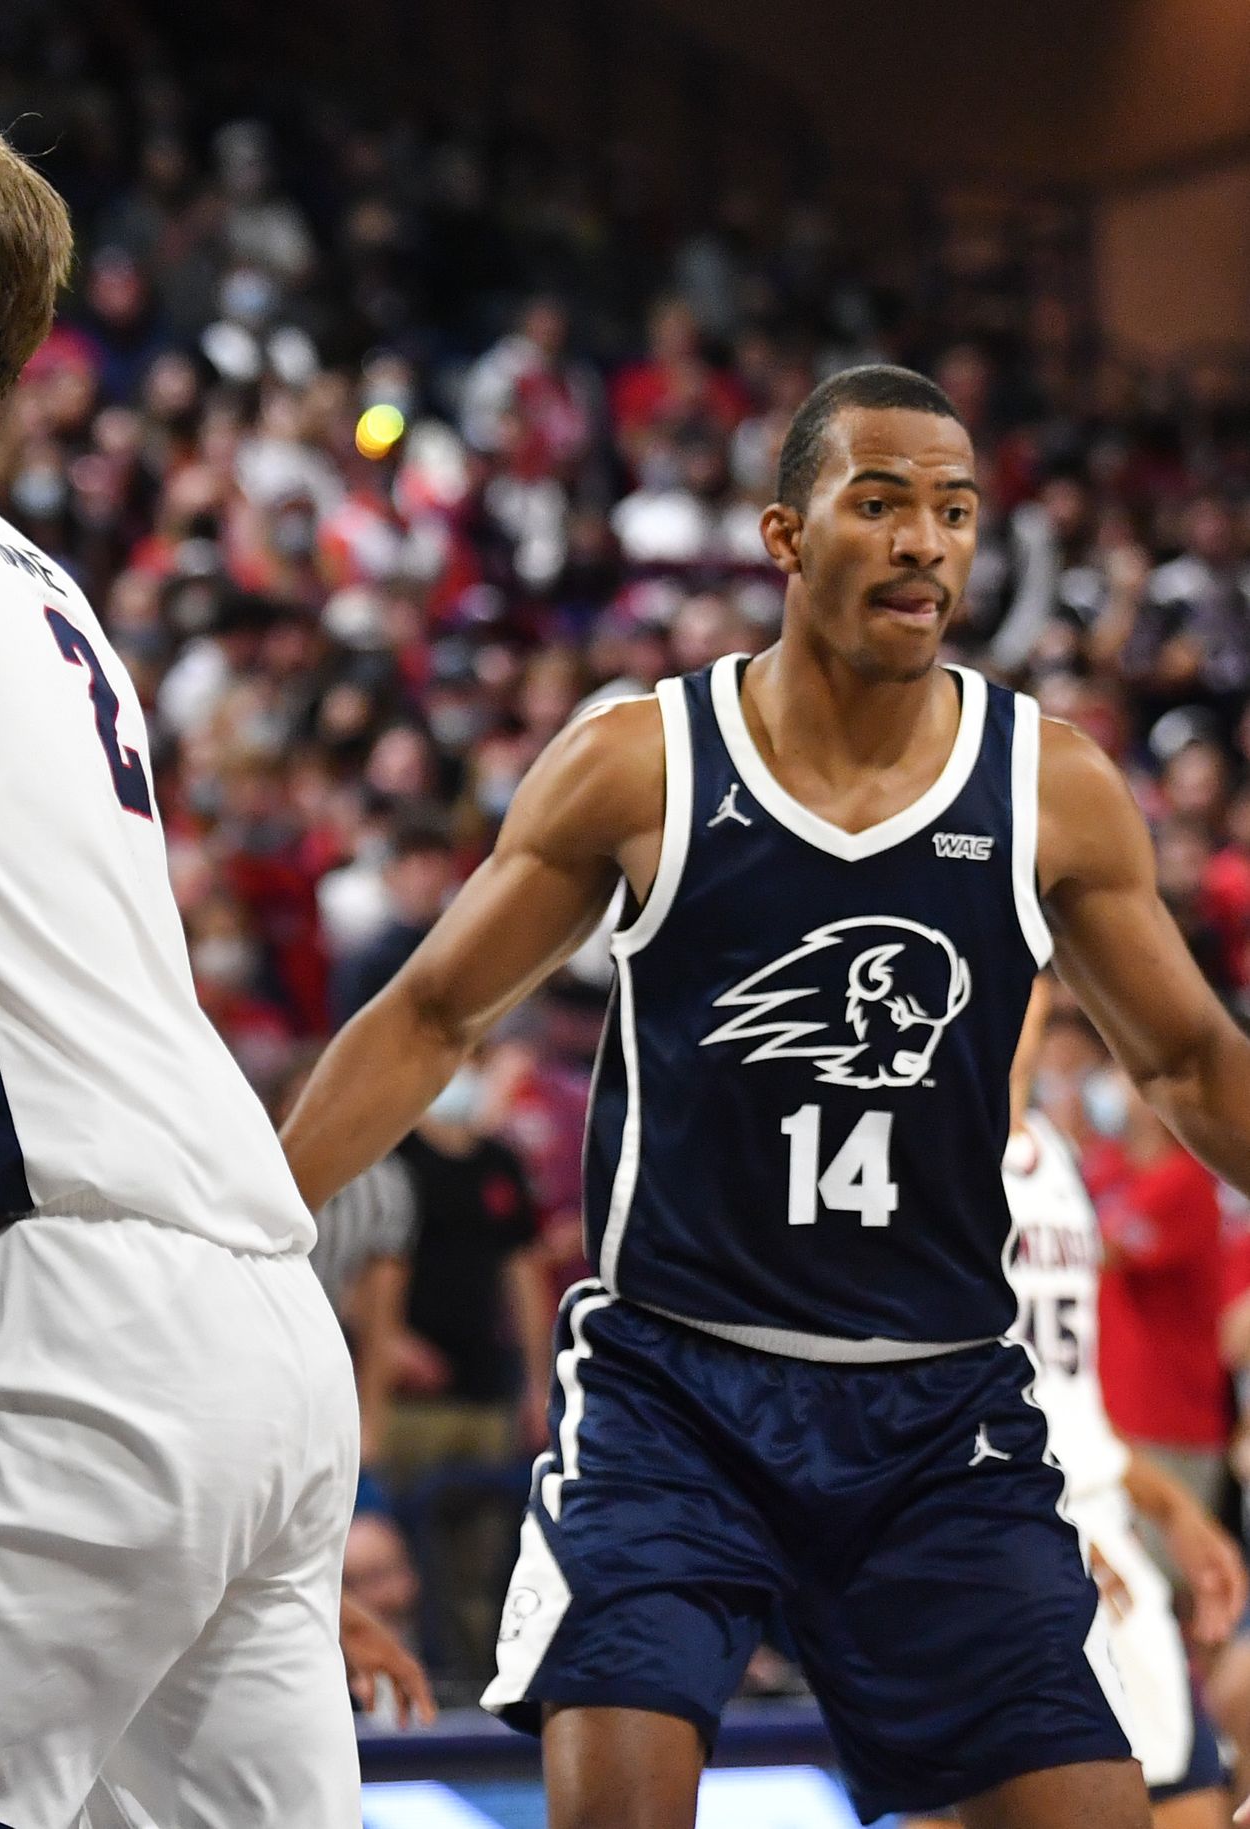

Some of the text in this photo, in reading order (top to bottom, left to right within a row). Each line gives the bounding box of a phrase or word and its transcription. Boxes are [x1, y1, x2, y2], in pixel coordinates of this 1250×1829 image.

[43, 603, 154, 823] 2
[932, 832, 995, 861] WAC
[780, 1103, 899, 1227] 14
